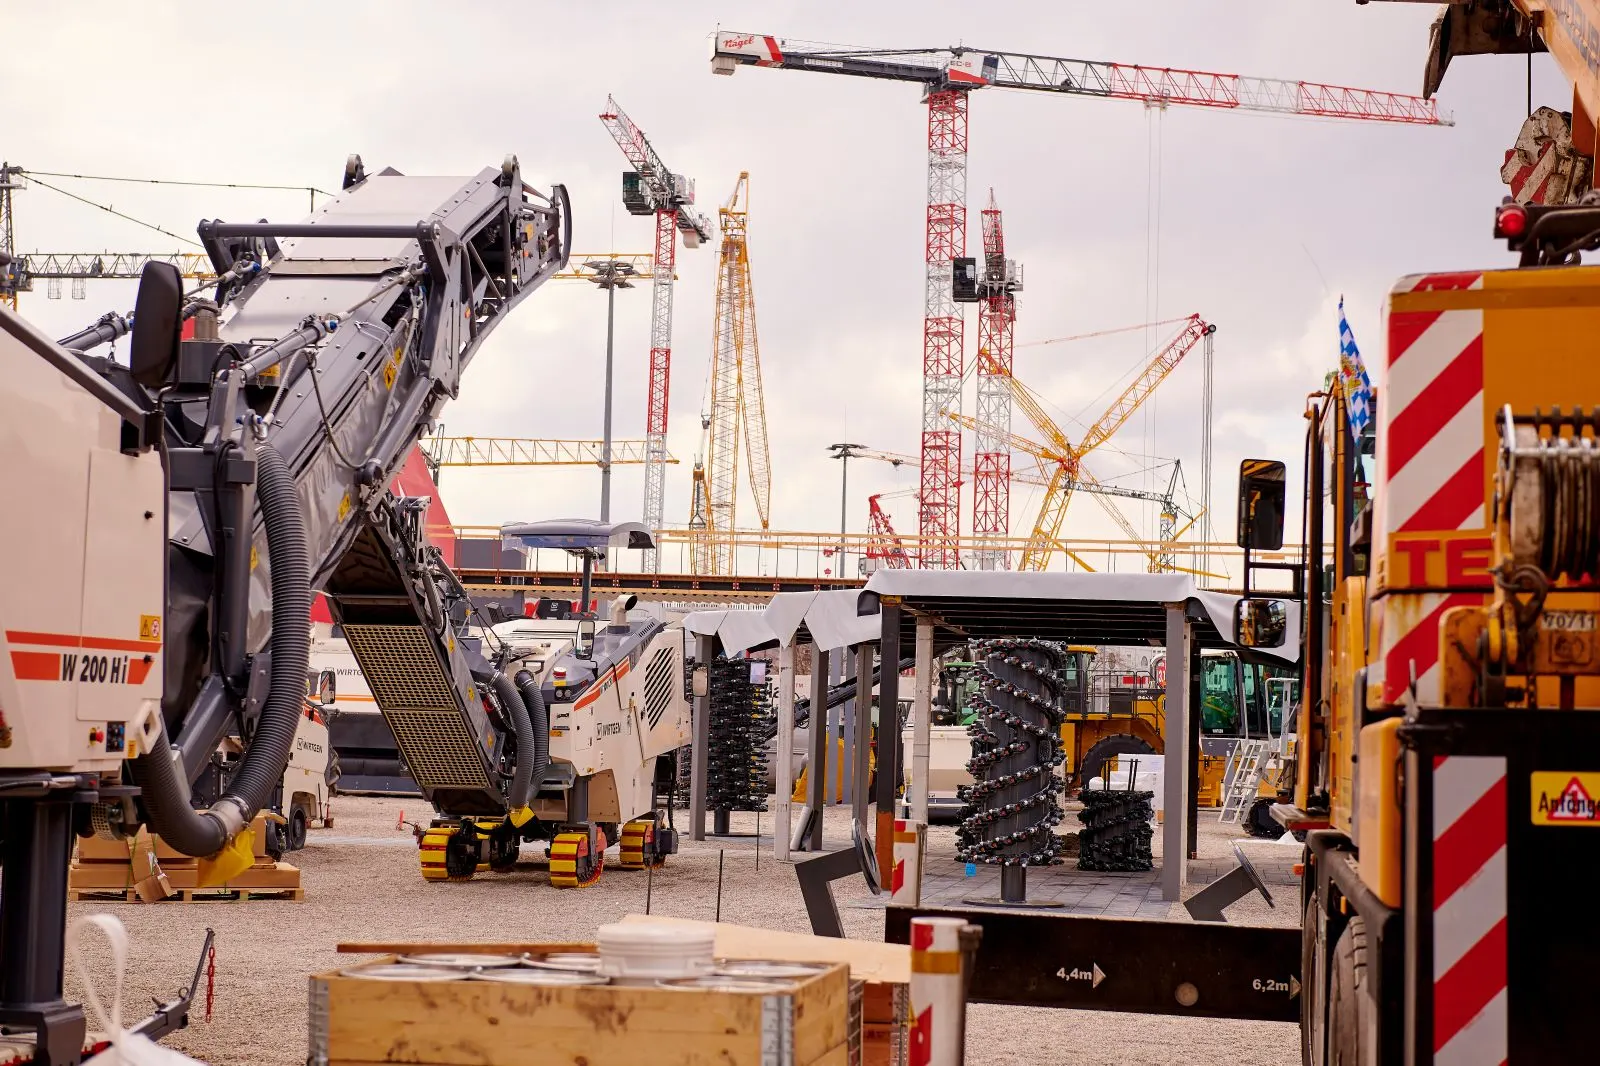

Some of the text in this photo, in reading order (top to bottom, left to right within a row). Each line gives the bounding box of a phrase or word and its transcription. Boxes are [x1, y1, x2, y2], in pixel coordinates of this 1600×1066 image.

[62, 653, 77, 682] W
[80, 654, 107, 683] 200
[1056, 967, 1093, 981] 4,4m
[1252, 978, 1289, 992] 6,2m
